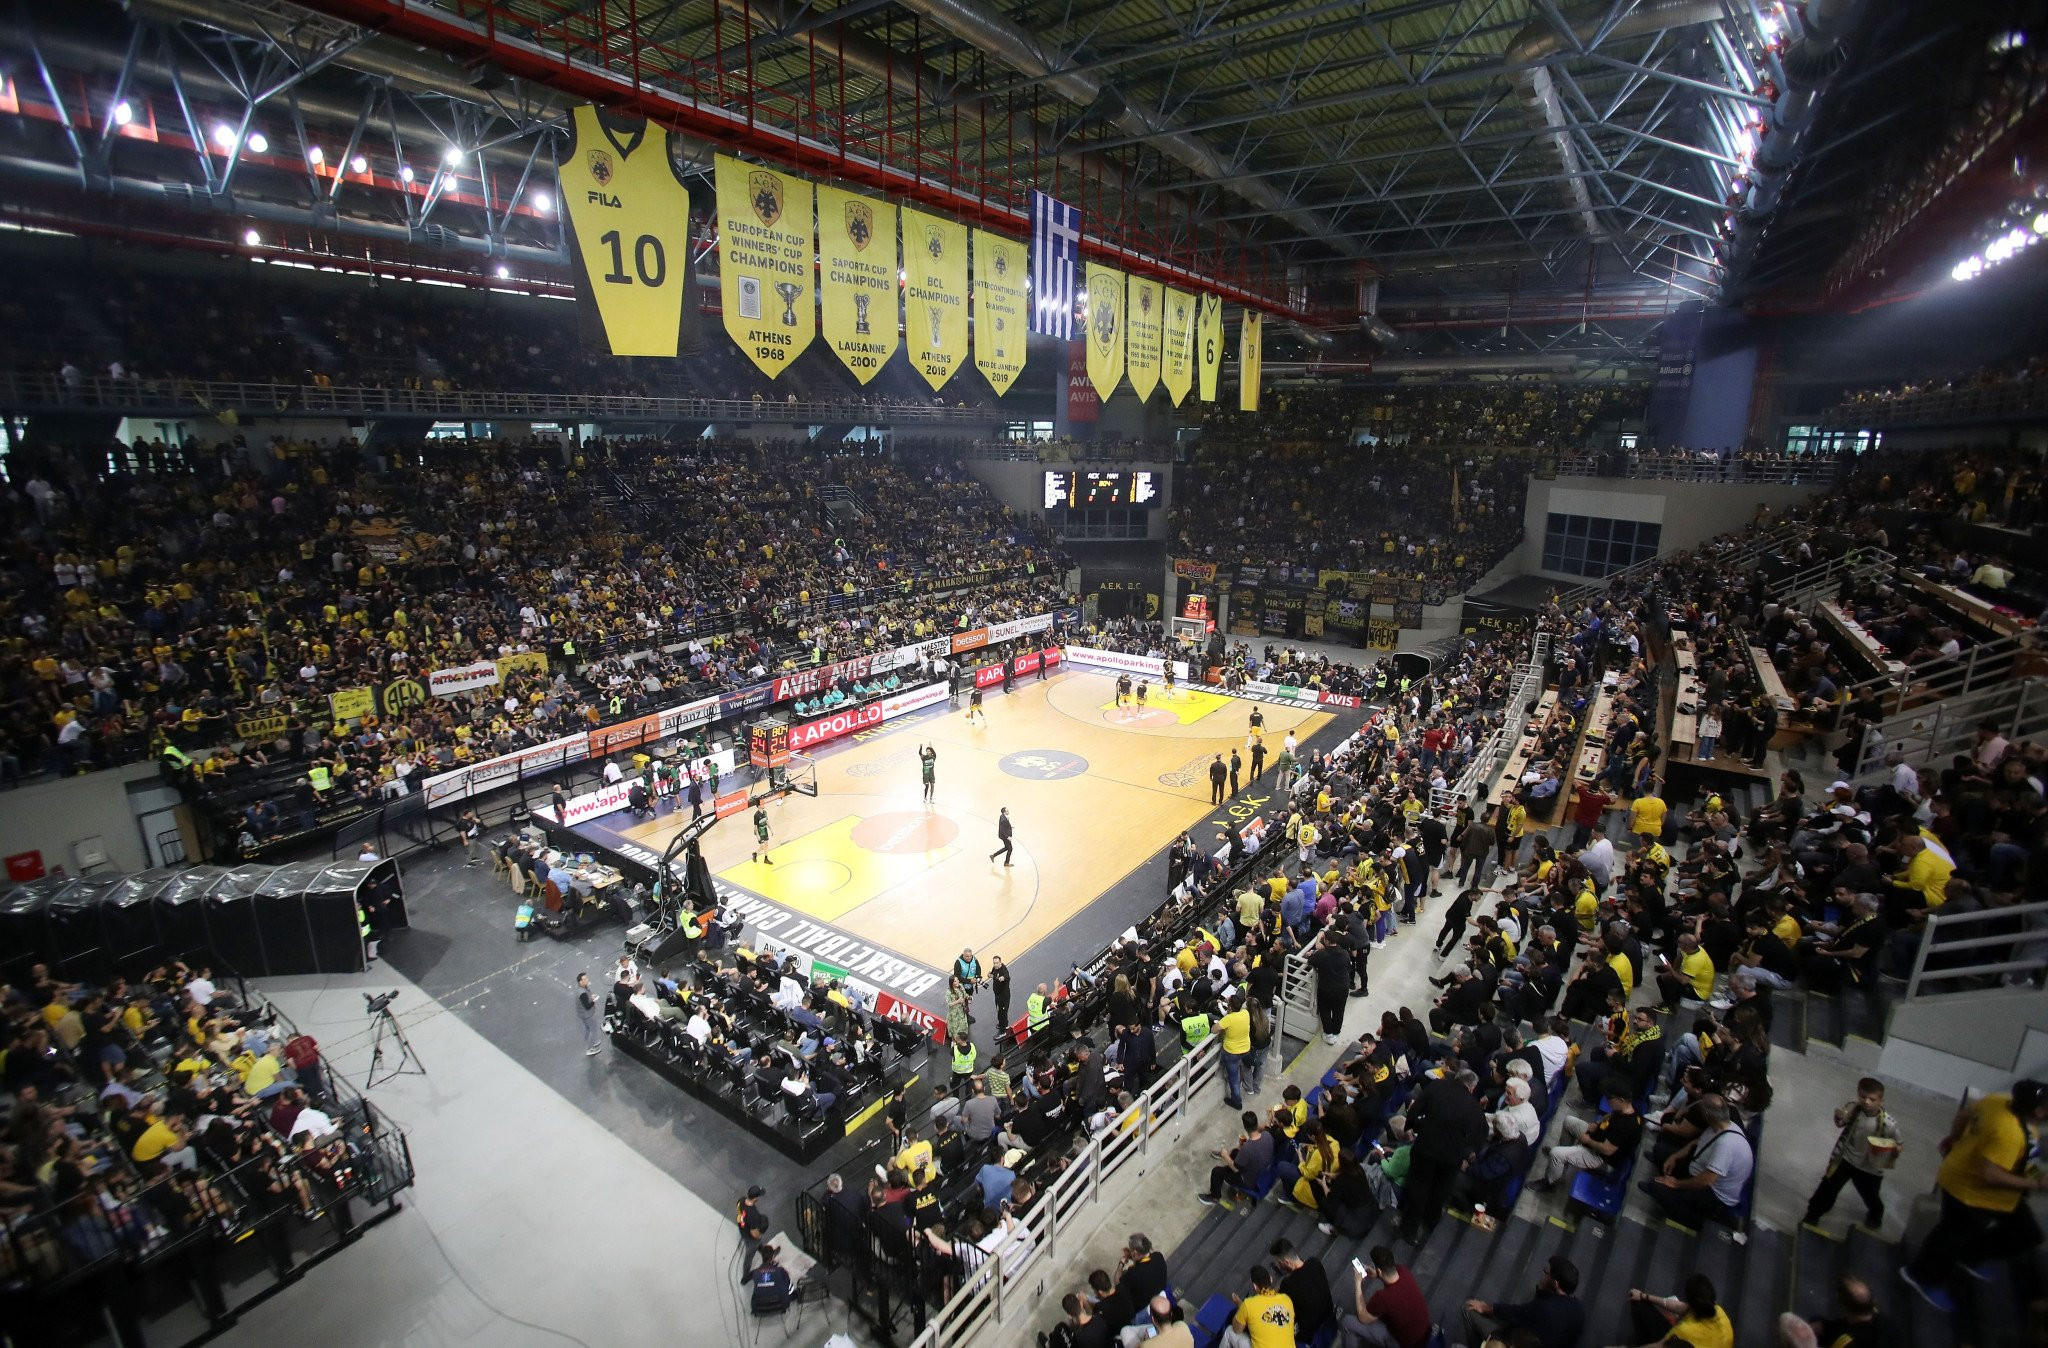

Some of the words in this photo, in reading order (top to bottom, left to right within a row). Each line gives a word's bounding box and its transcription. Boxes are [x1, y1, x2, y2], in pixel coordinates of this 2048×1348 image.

[588, 190, 622, 208] FILA
[728, 220, 783, 241] EUROPEAN
[786, 235, 805, 246] CUP
[731, 235, 781, 254] WINNERS'
[784, 248, 802, 259] CUP
[600, 230, 666, 288] 10
[730, 250, 804, 276] CHAMPIONS
[832, 257, 870, 273] SAPORTA
[871, 265, 888, 275] CUP
[830, 271, 890, 290] CHAMPIONS
[927, 276, 944, 289] BCL
[909, 287, 960, 306] CHAMPIONS
[994, 294, 1006, 303] CUP
[985, 301, 1016, 315] CHAMPIONS
[748, 330, 792, 345] ATHENS
[755, 347, 785, 361] 1968
[838, 341, 887, 354] LAUSANNE
[1206, 339, 1214, 365] 6
[1248, 344, 1255, 360] 13
[850, 356, 877, 368] 2000
[920, 351, 951, 364] ATHENS
[926, 364, 947, 376] 2018
[978, 360, 990, 368] RIO
[990, 361, 998, 369] DE
[998, 363, 1020, 373] JANEIRO
[1659, 366, 1682, 375] Allianz
[992, 373, 1009, 382] 2019
[1070, 391, 1097, 402] AVIS
[1100, 582, 1124, 591] A.E.K.
[1187, 601, 1199, 610] 24
[955, 632, 986, 647] betsson
[995, 626, 1018, 638] SUNEL
[829, 658, 868, 686] AVIS
[778, 671, 820, 700] AVIS
[1264, 695, 1326, 711] LEAGUE
[1324, 693, 1354, 707] AVIS
[804, 705, 881, 743] APOLLO
[851, 715, 925, 740] ATHENS
[596, 721, 655, 747] betsson
[751, 737, 766, 752] 24
[770, 735, 787, 752] 24
[717, 798, 745, 813] betsson
[779, 919, 942, 998] BASKETBALL
[887, 1001, 935, 1031] AVIS
